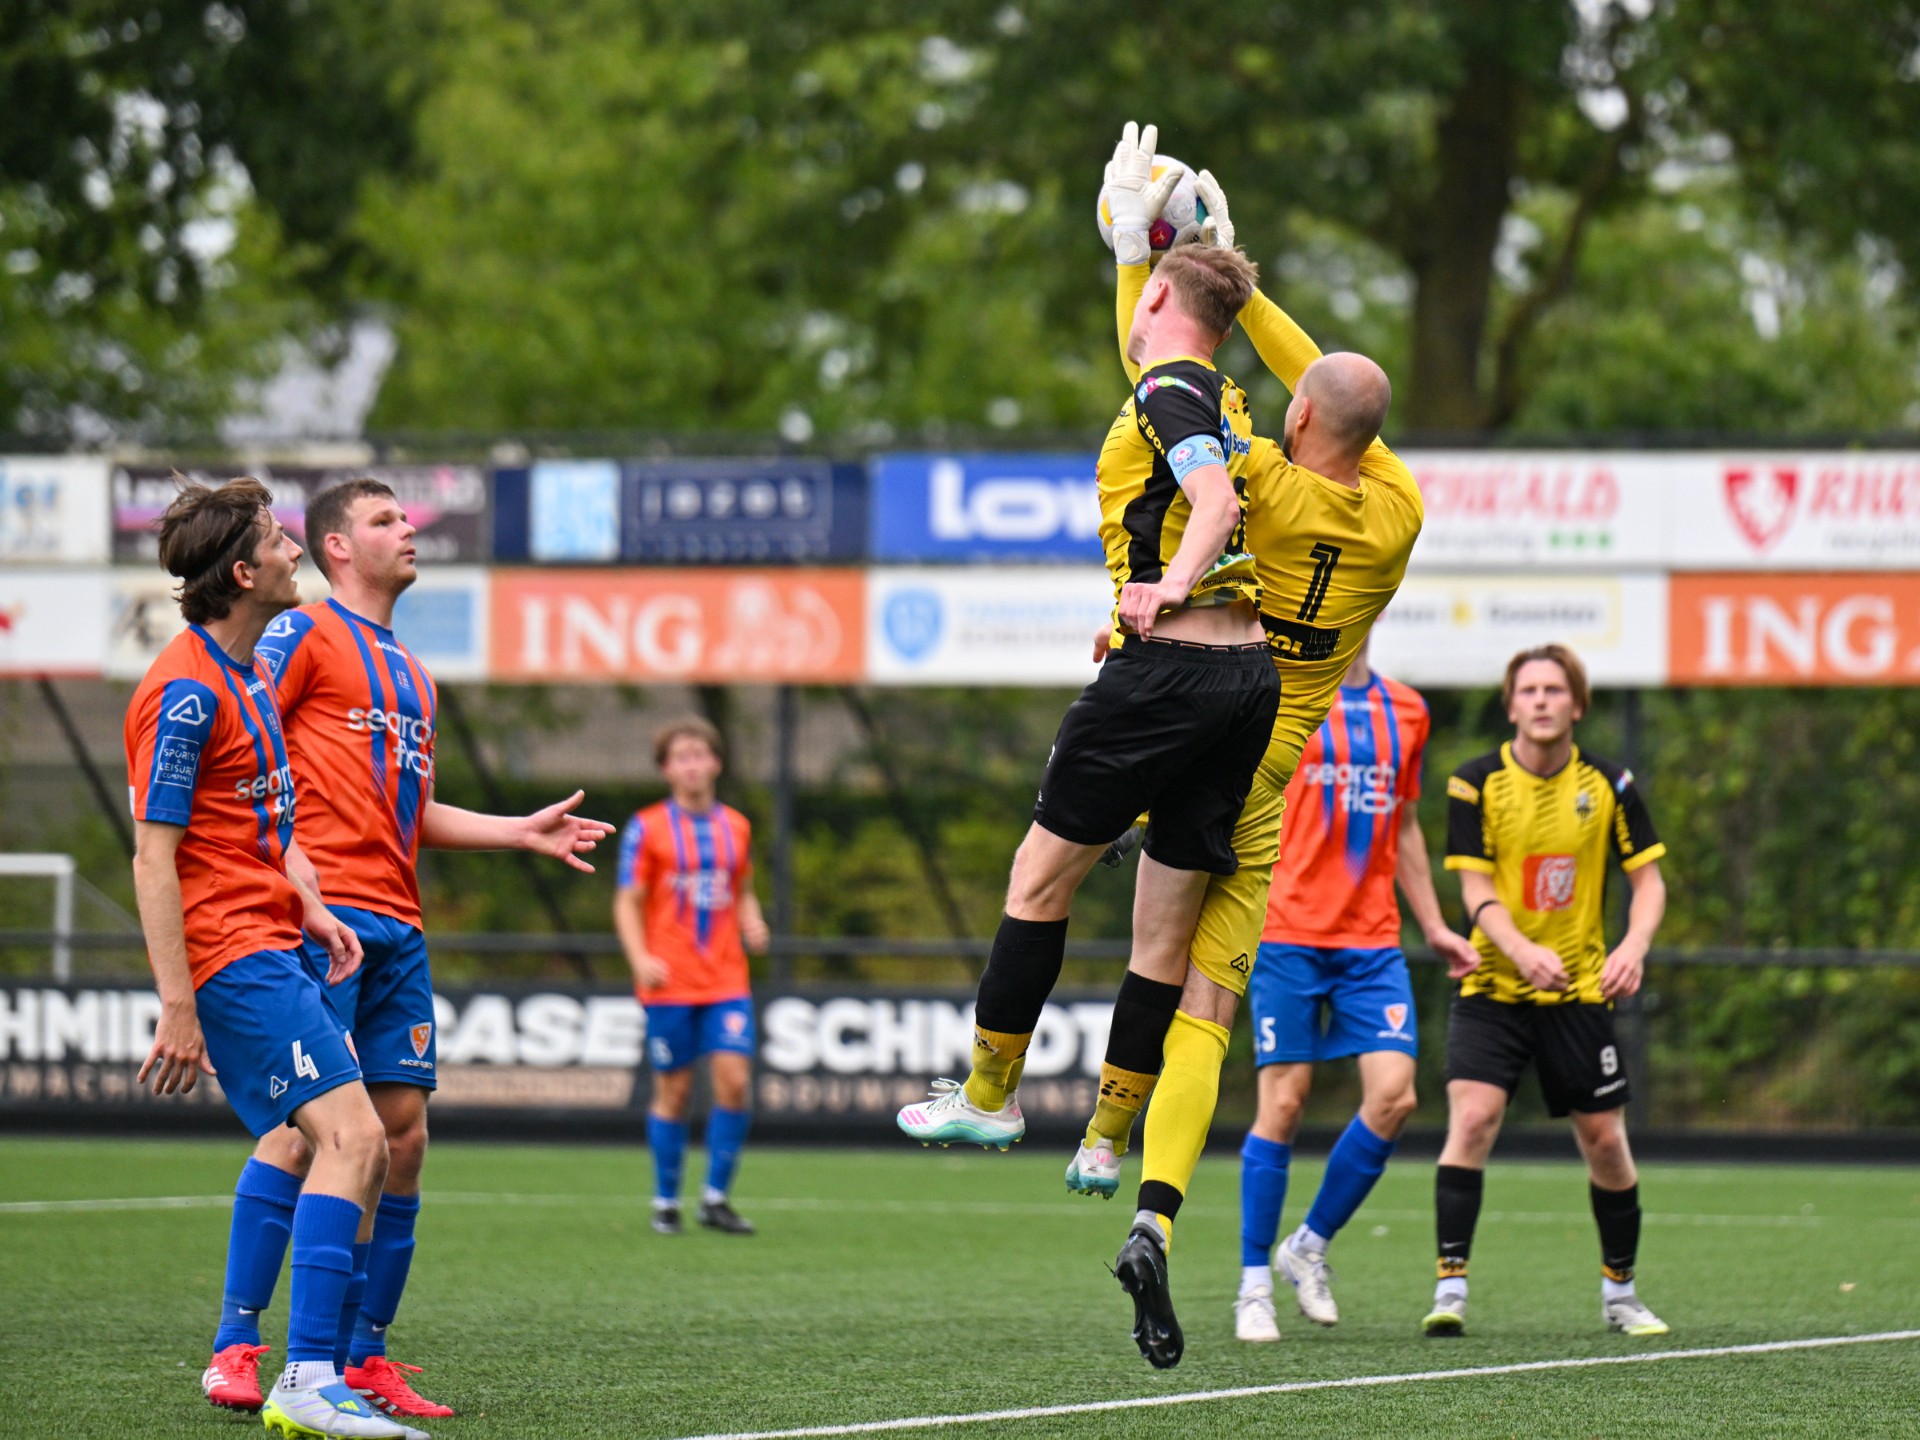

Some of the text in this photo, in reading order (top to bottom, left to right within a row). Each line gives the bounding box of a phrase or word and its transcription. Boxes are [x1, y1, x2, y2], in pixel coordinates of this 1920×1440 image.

[521, 594, 704, 675] ING
[1701, 596, 1898, 677] ING
[159, 762, 193, 776] LEISURE
[163, 748, 196, 762] SPORTS
[1304, 760, 1396, 789] search
[1260, 1016, 1277, 1053] 5
[292, 1039, 321, 1080] 4
[1599, 1044, 1619, 1076] 9
